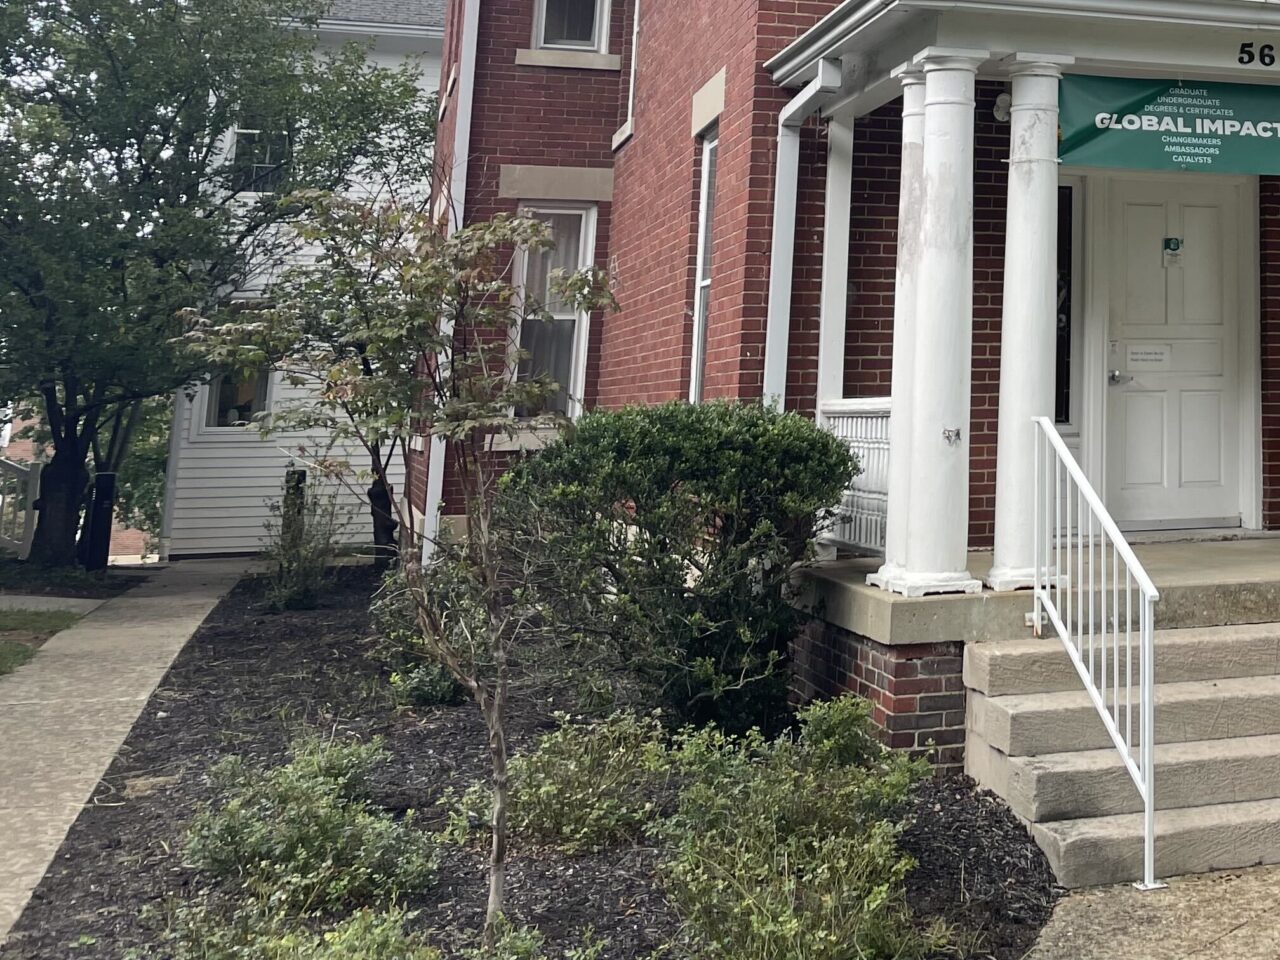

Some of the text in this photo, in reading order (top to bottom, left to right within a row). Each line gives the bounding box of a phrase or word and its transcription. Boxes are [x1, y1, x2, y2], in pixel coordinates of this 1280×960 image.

[1238, 41, 1275, 66] 56
[1169, 87, 1208, 97] GRADUATE
[1157, 96, 1220, 106] UNDERGRADUATE
[1144, 104, 1178, 113] DEGREES
[1185, 106, 1234, 116] CERTIFICATES
[1095, 112, 1192, 133] GLOBAL
[1161, 135, 1222, 145] CHANGEMAKERS
[1164, 145, 1219, 155] AMBASSADORS
[1172, 154, 1212, 164] CATALYSTS
